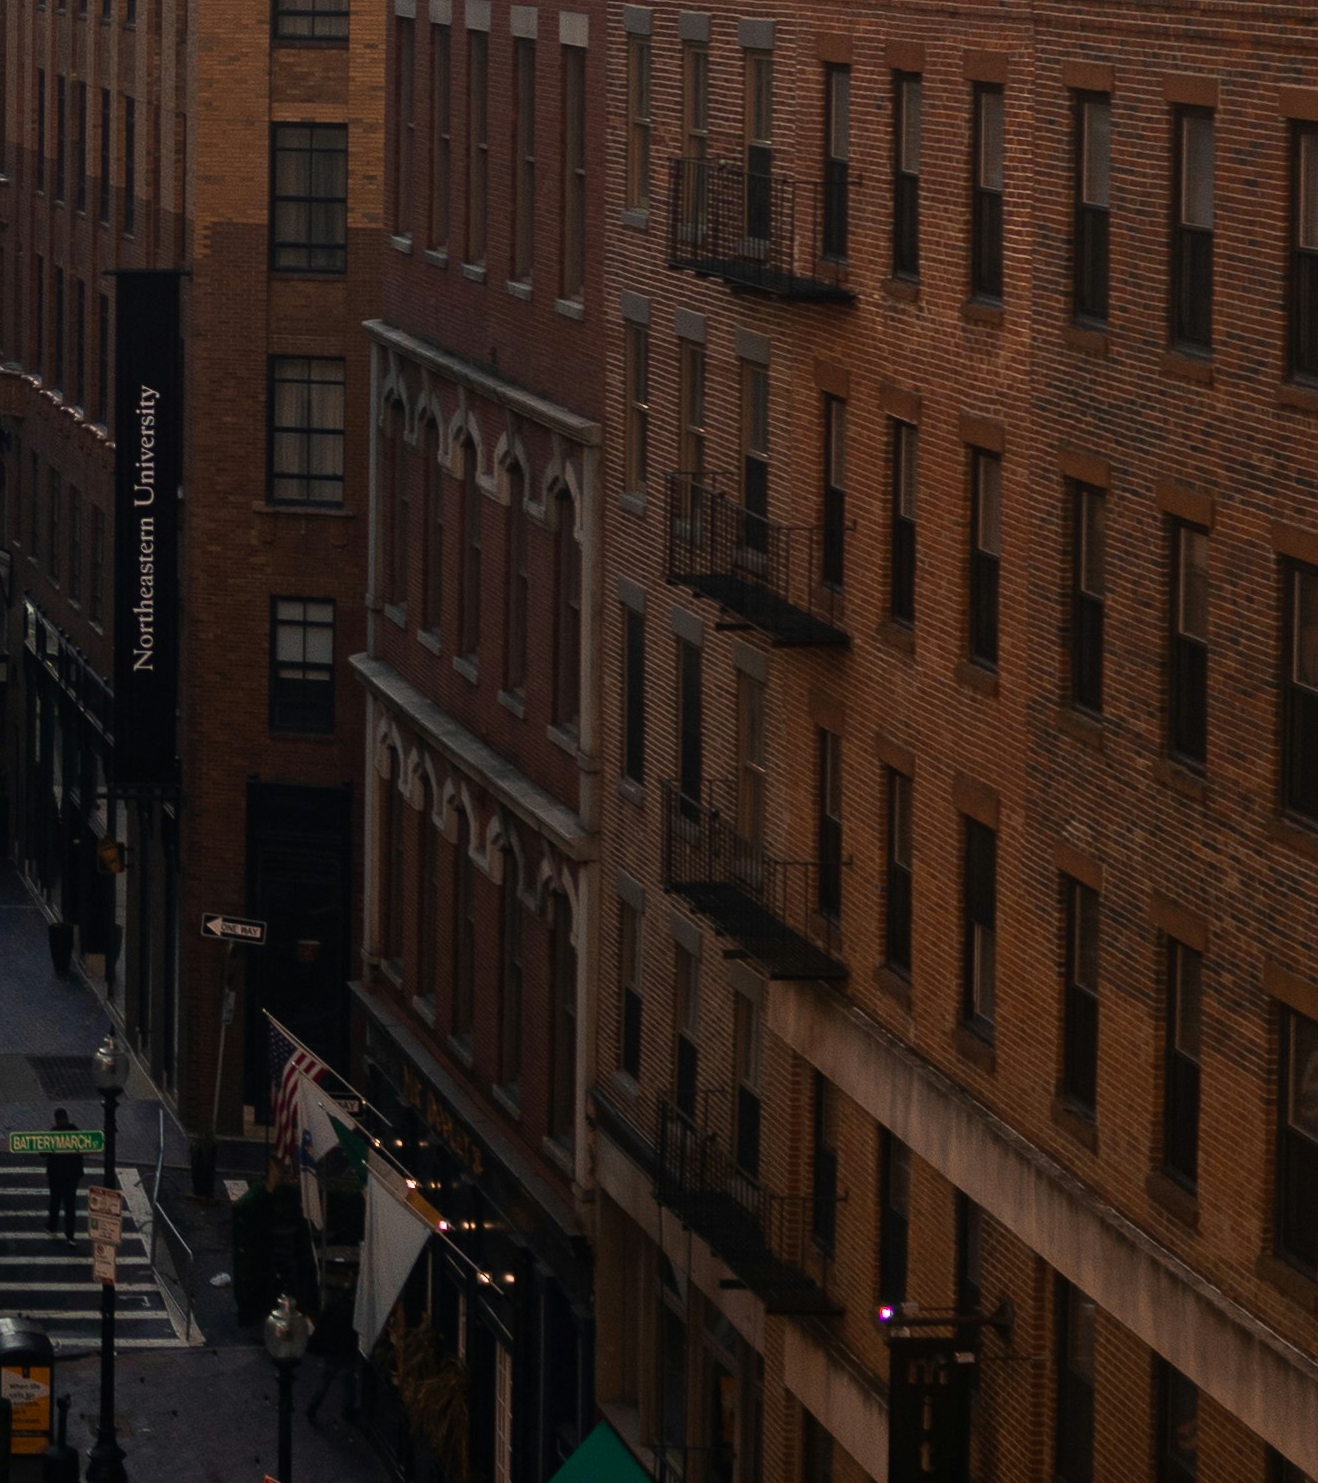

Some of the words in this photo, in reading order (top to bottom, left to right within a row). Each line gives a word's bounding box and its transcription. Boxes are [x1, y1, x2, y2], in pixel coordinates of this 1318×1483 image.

[133, 384, 161, 508] University
[133, 516, 155, 672] Northeastern
[221, 923, 237, 933] ONE
[241, 926, 259, 935] WAY
[14, 1135, 92, 1150] BATTERYMARCH
